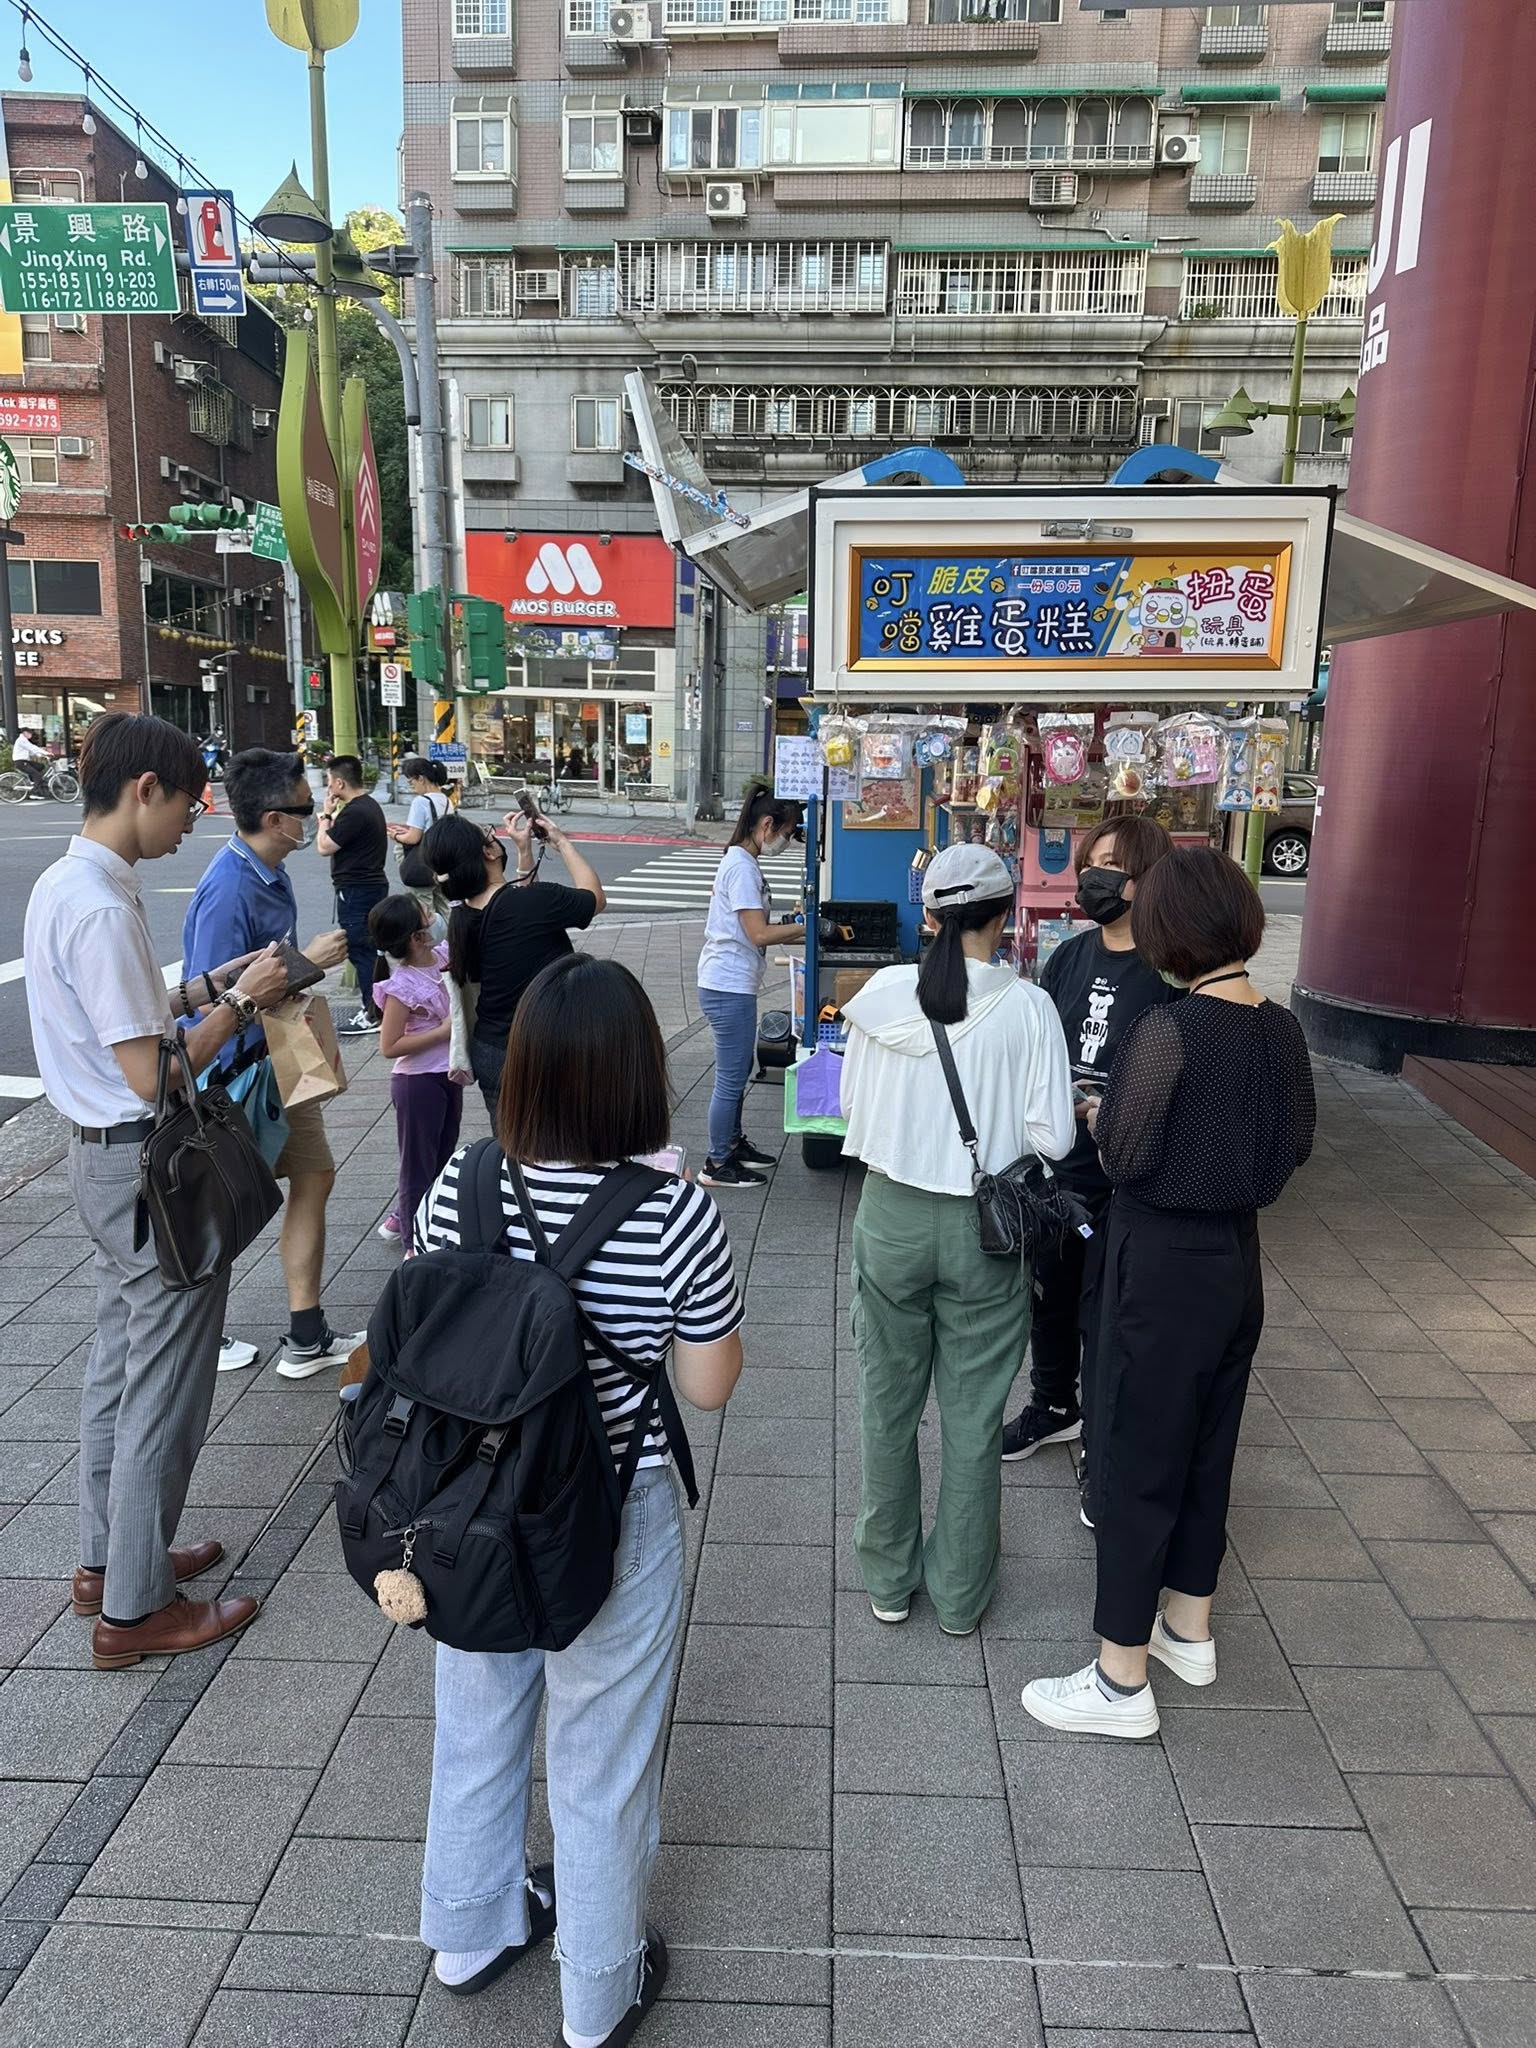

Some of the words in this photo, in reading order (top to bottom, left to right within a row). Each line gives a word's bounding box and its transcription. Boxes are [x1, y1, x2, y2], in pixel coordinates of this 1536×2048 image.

[11, 212, 151, 244] 景興路
[20, 249, 108, 272] JingXing
[120, 249, 152, 266] Rd.
[19, 271, 80, 289] 155-185
[95, 271, 156, 289] 191-203
[22, 291, 83, 308] 116-172
[97, 291, 158, 308] 188-200
[926, 565, 991, 595] 脆皮
[1187, 567, 1274, 622] 扭蛋
[510, 599, 549, 615] MOS
[927, 599, 1095, 656] 雞蛋糕
[1200, 615, 1245, 637] 玩具
